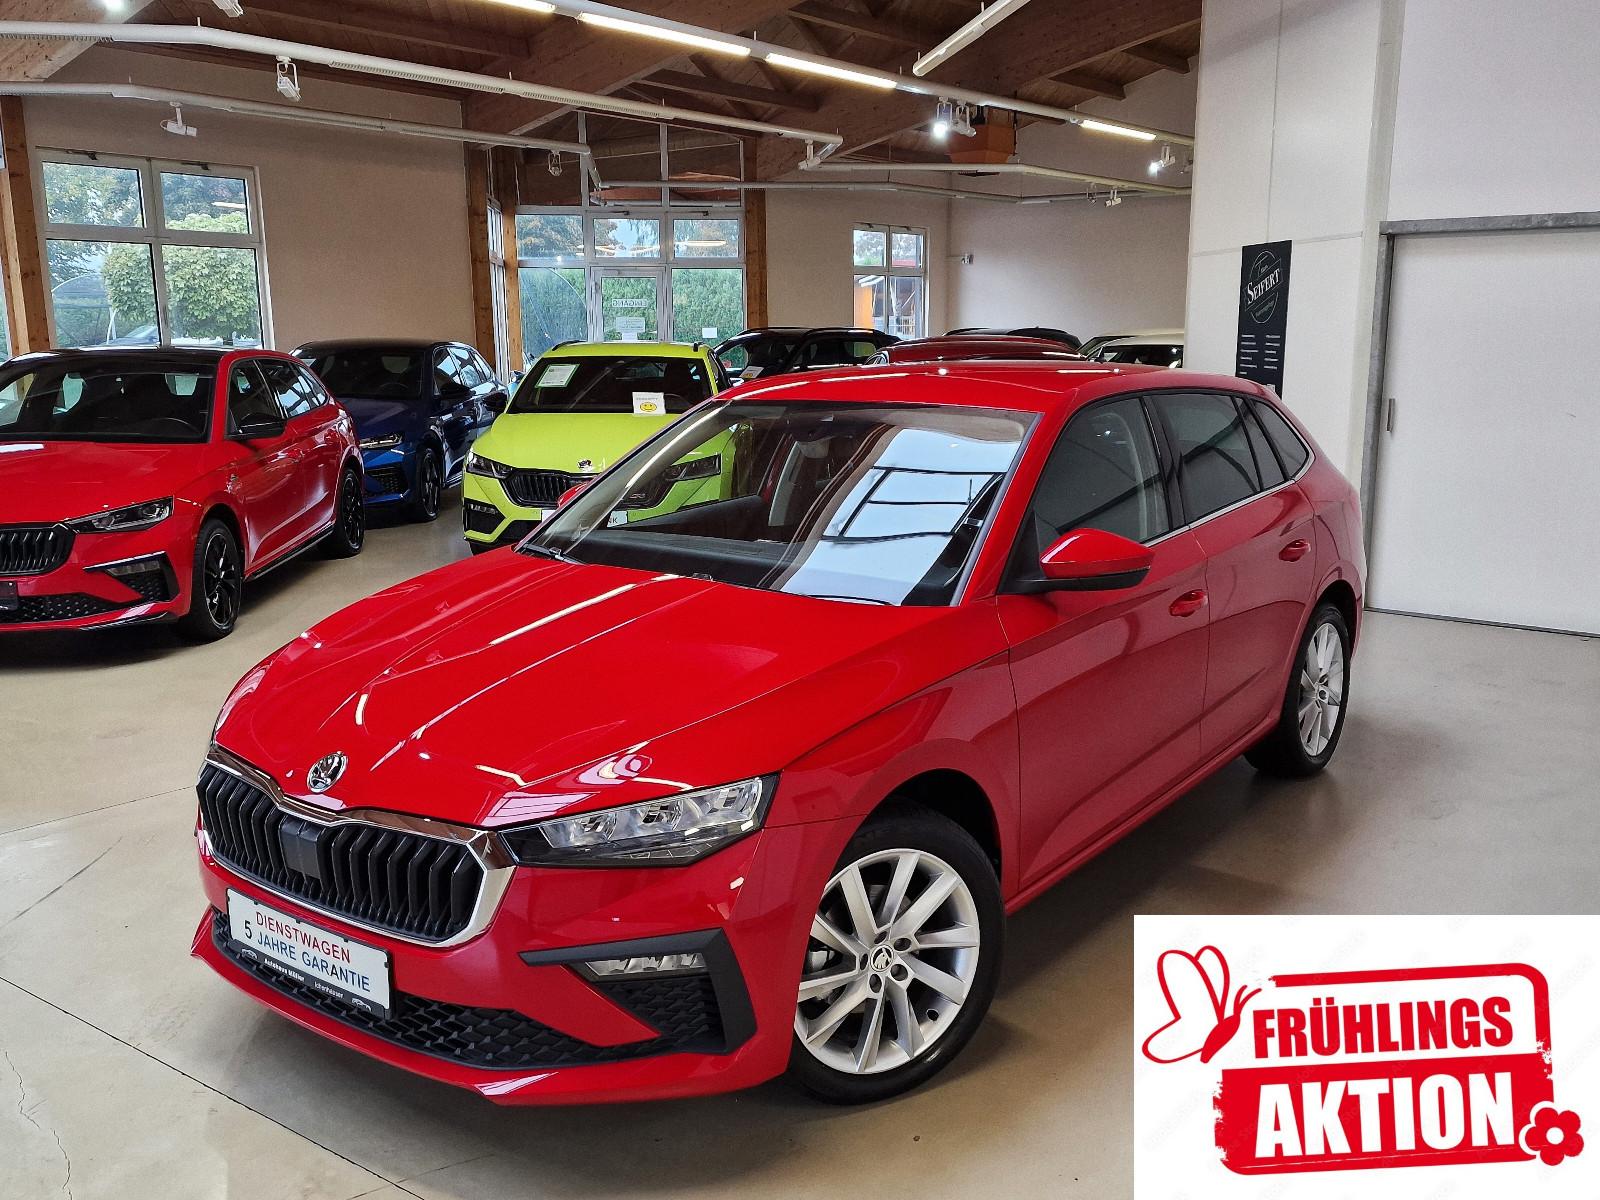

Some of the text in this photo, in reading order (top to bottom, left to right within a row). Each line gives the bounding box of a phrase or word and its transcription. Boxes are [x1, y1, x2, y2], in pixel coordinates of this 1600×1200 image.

[244, 920, 371, 993] 5 JAHRE GARANTIE
[255, 911, 352, 964] DIENSTWAGEN
